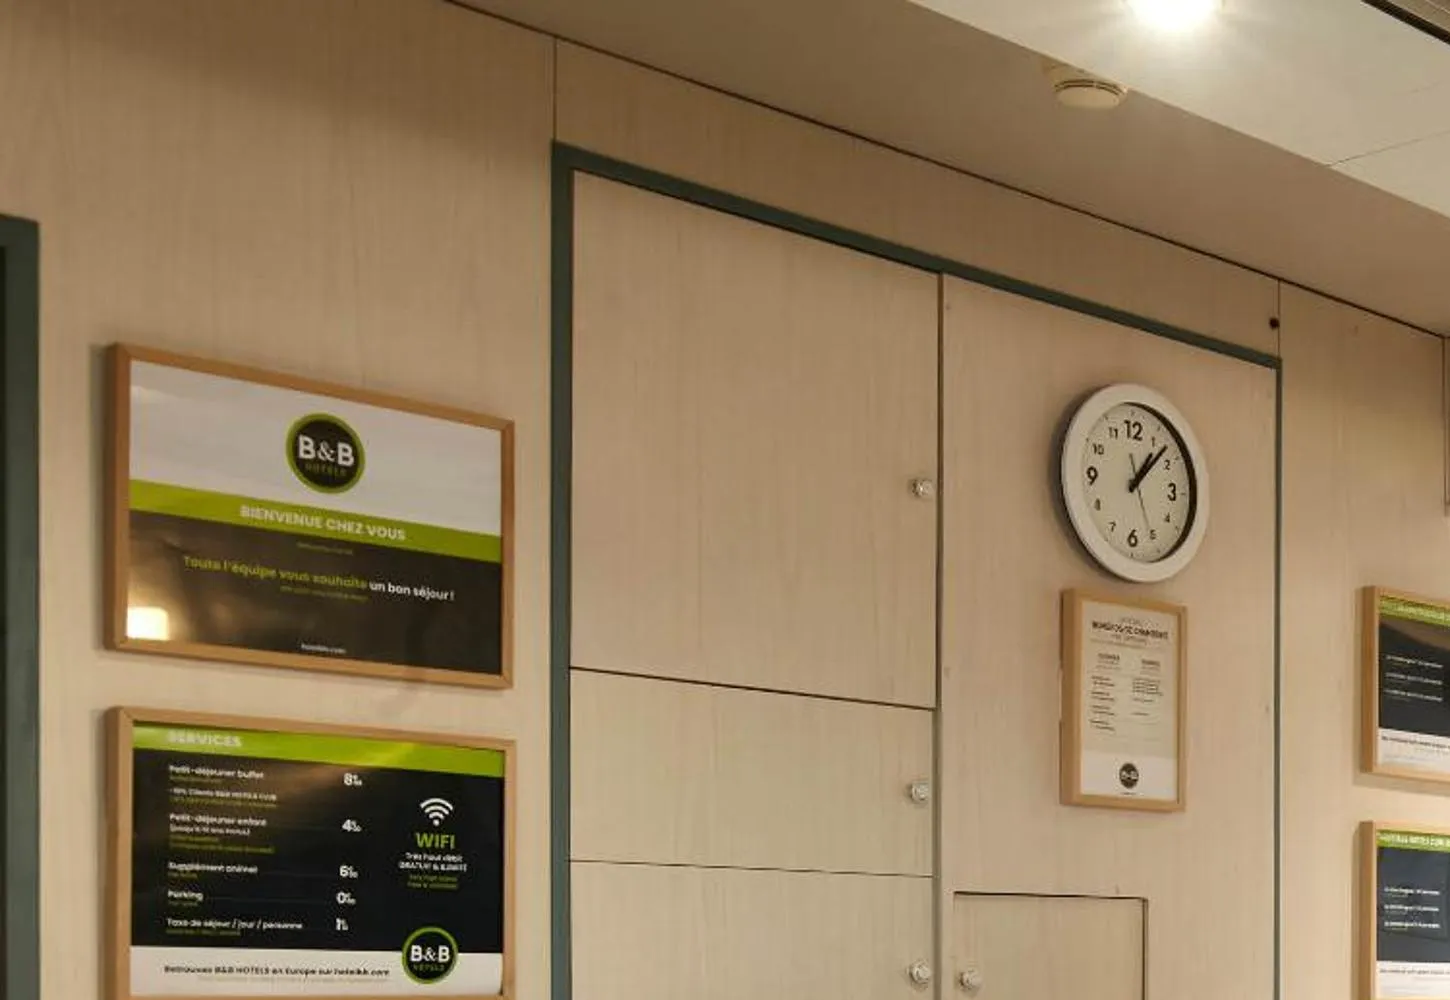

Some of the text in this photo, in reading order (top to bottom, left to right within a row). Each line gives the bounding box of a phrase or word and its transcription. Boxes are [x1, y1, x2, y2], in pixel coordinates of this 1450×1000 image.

[1109, 427, 1119, 440] 11
[1124, 420, 1143, 440] 12
[299, 435, 354, 466] B&B
[1093, 443, 1105, 455] 10
[1164, 460, 1171, 470] 2
[1087, 467, 1098, 485] 9
[1168, 483, 1177, 501] 3
[240, 505, 406, 541] BIENVENUE CHEZ VOUS
[1164, 513, 1171, 523] 4
[1109, 522, 1116, 532] 7
[1150, 529, 1157, 540] 5
[1128, 529, 1138, 547] 6
[184, 556, 222, 571] Toute
[278, 571, 310, 581] vous
[312, 575, 368, 589] souhaite
[369, 582, 385, 592] un
[388, 582, 411, 595] bon
[169, 729, 242, 747] SERVICES
[237, 770, 264, 778] buffet
[416, 832, 456, 849] WIFI
[168, 890, 204, 901] Parking
[167, 918, 189, 927] Taxe
[411, 945, 450, 963] B&B
[236, 966, 269, 975] HOTELS
[285, 967, 316, 977] Europe
